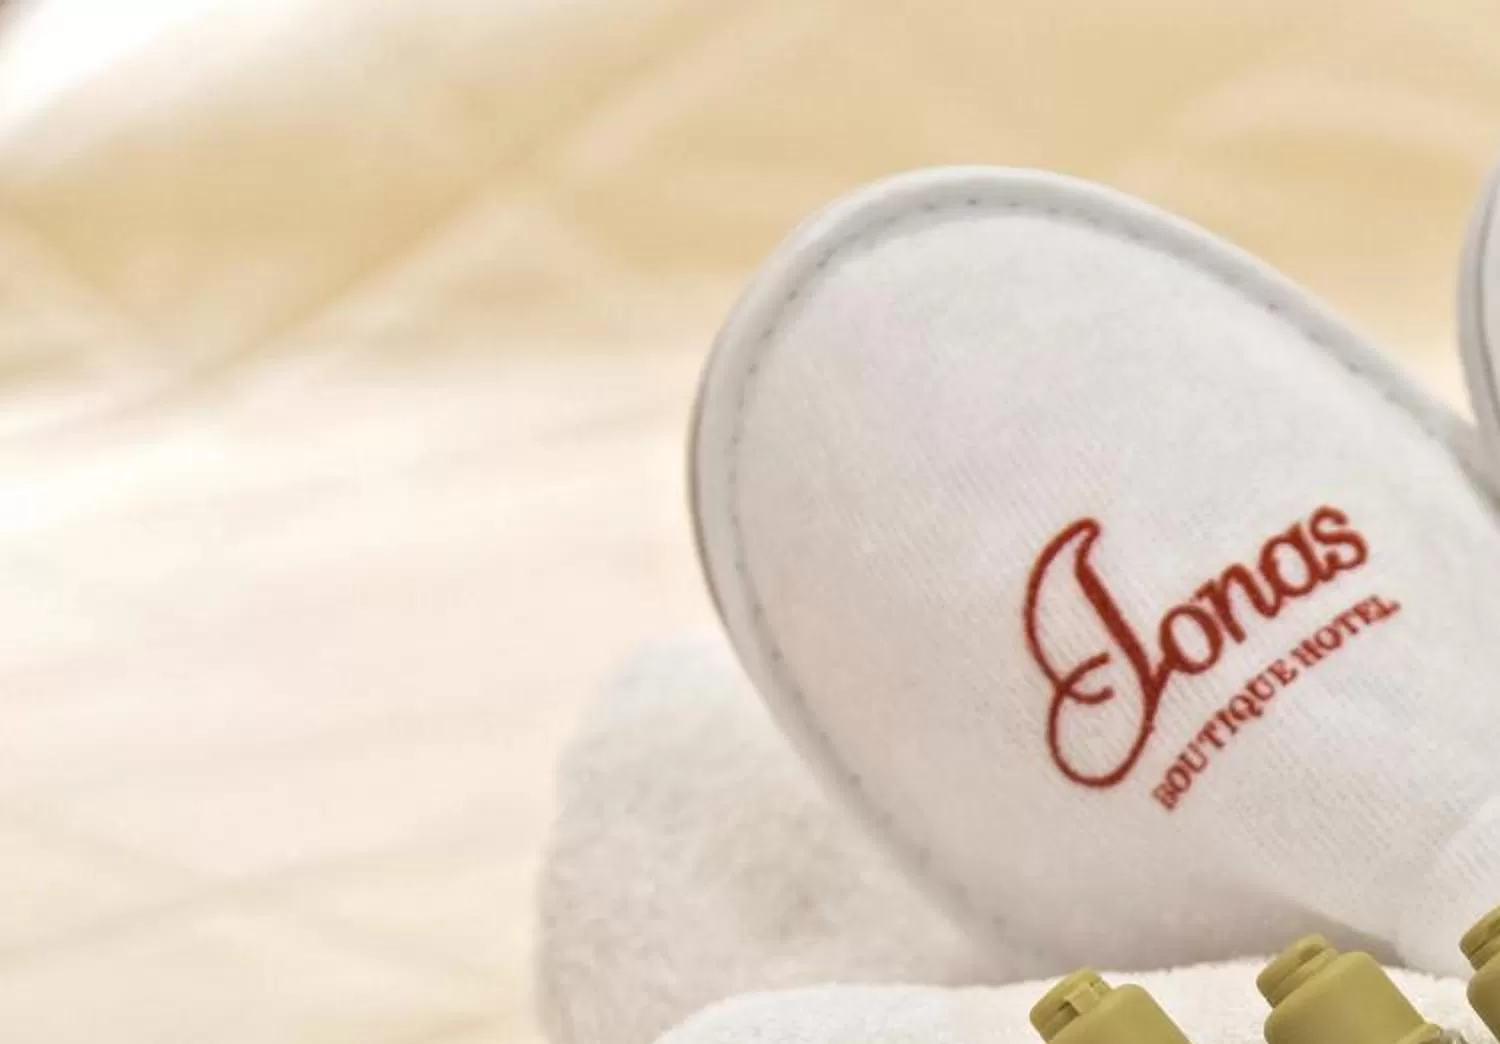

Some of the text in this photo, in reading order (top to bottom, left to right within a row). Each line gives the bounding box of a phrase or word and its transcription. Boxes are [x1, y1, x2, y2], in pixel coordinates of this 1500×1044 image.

[1023, 505, 1369, 788] Jonas
[1152, 594, 1401, 811] BOUTIQUE HOTEL
